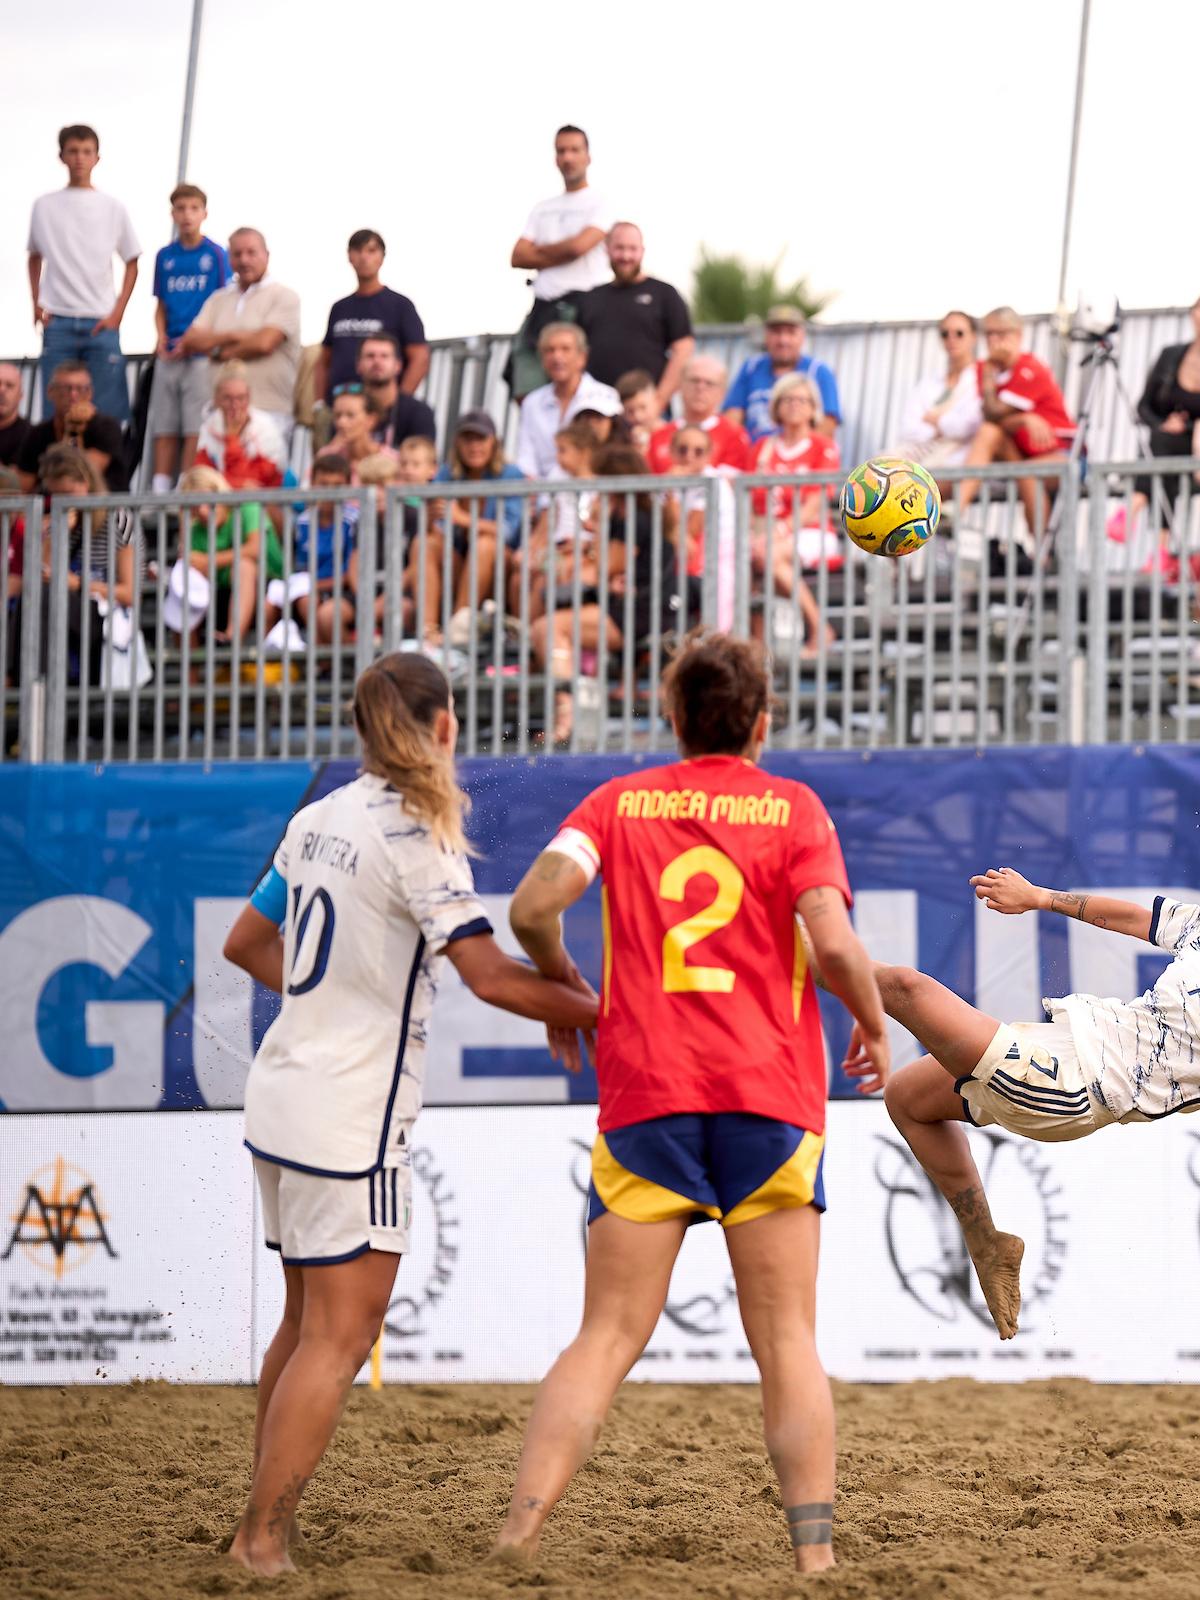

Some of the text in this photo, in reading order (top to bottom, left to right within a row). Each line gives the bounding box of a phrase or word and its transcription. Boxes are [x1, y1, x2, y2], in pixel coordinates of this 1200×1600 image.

[617, 789, 791, 827] ANDREA MIRÓN
[659, 844, 744, 993] 2
